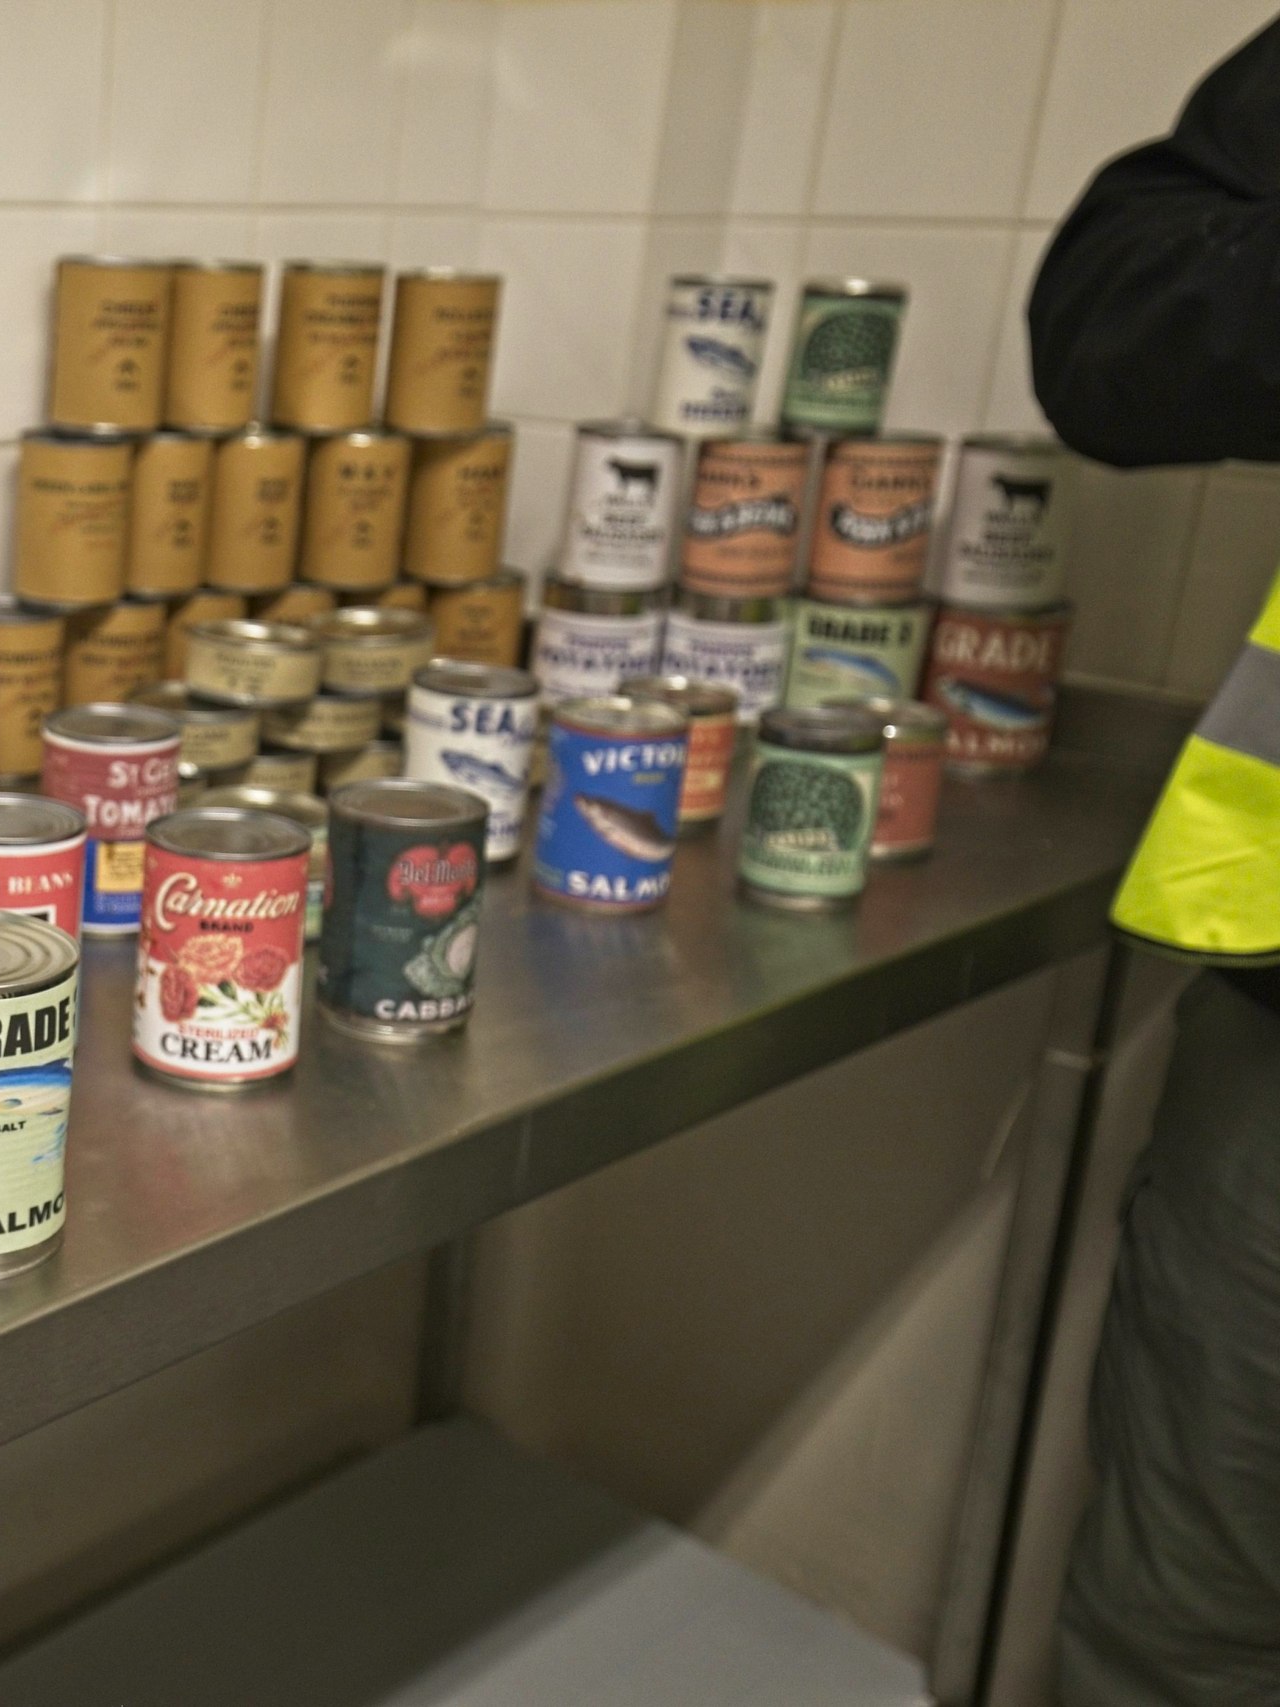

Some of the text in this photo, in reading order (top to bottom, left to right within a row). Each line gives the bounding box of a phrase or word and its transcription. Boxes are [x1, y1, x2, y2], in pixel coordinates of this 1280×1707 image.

[450, 704, 516, 735] SEA
[156, 872, 300, 931] Carnation
[199, 920, 254, 934] BRAND
[160, 1032, 273, 1063] CREAM
